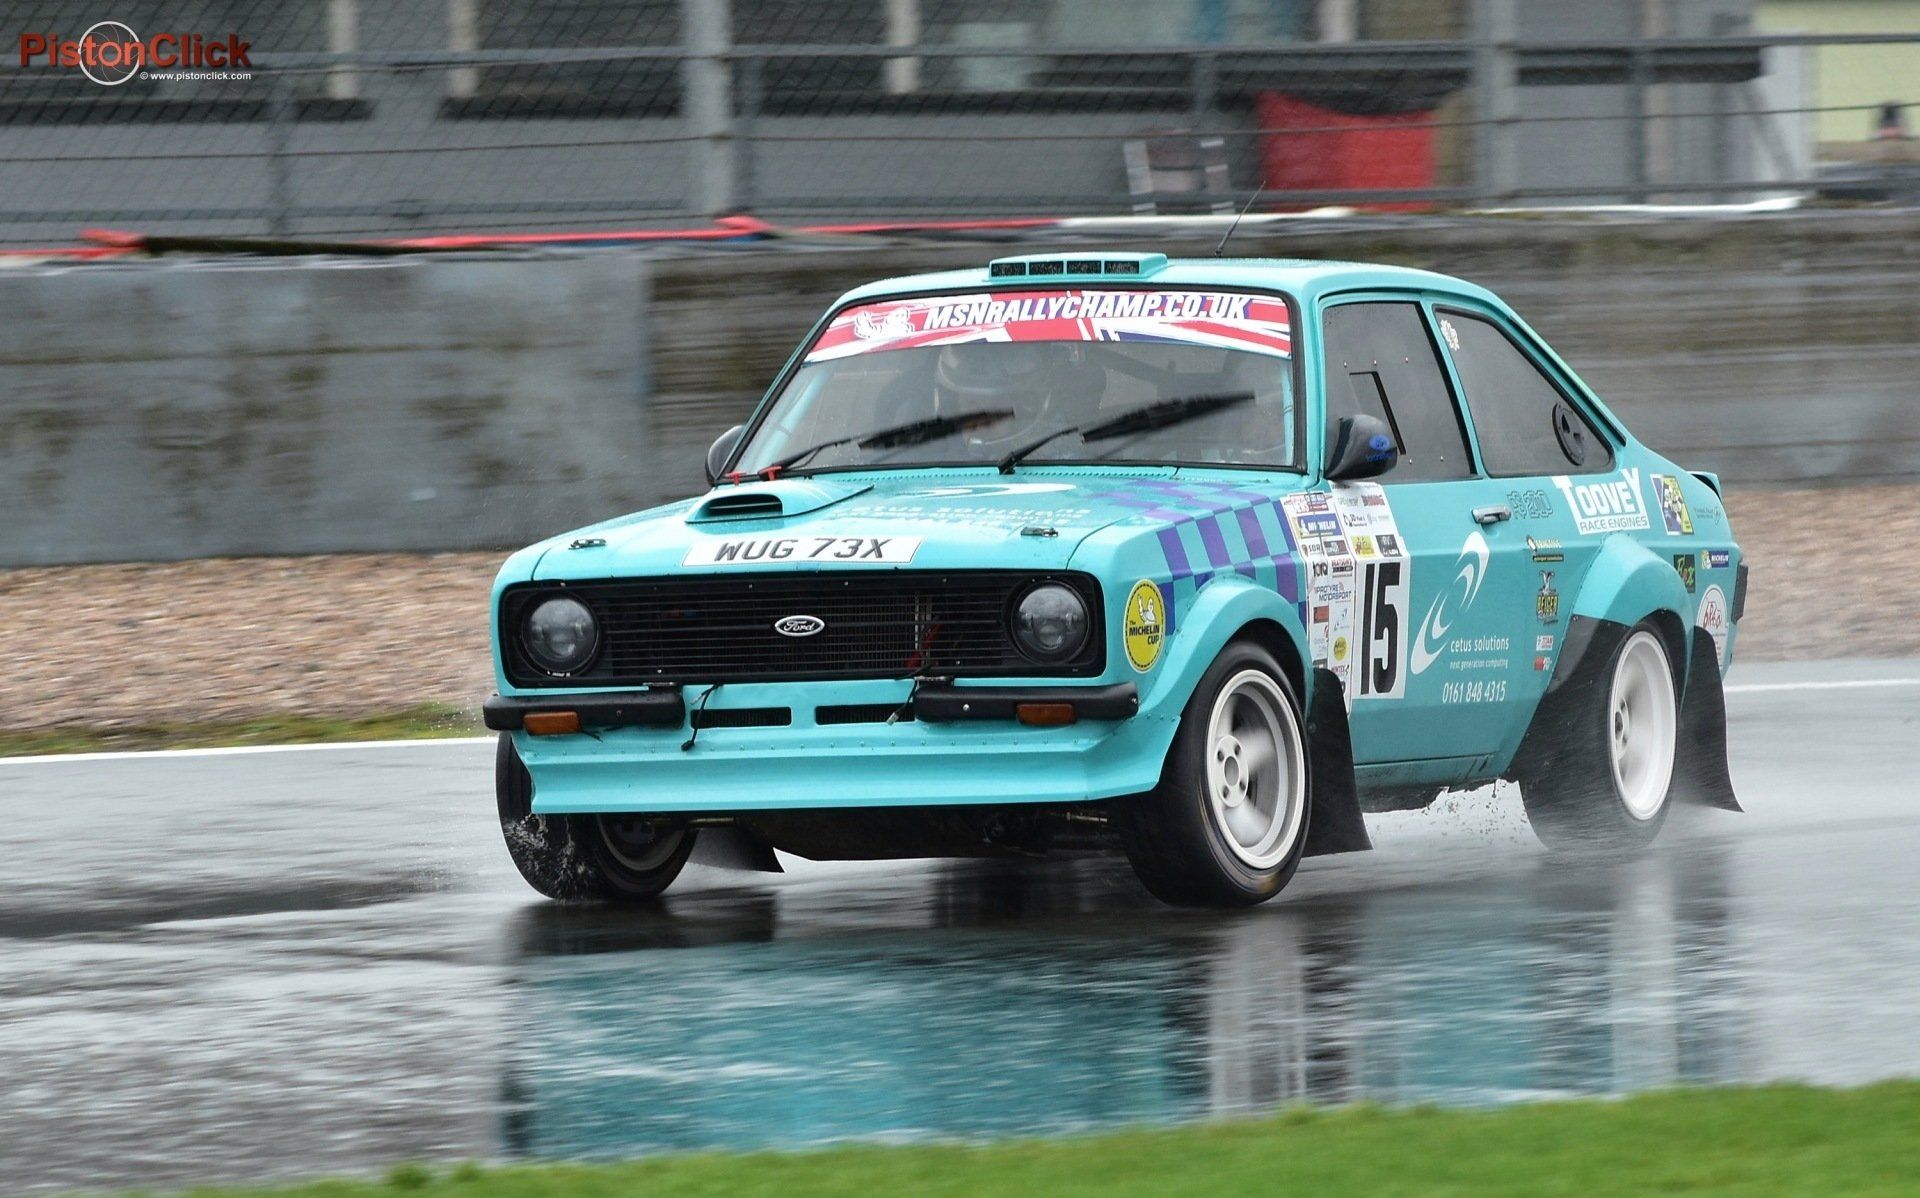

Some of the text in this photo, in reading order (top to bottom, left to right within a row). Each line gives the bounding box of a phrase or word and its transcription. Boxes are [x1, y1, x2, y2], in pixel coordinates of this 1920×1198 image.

[923, 293, 1250, 330] MSNRALLYCHAMP.CO.UK
[1580, 516, 1648, 533] RACE ENGINES
[714, 538, 893, 562] WUG 73X
[783, 620, 815, 633] Ford
[1129, 625, 1160, 636] MICHELIN
[1360, 562, 1401, 695] 15
[1147, 635, 1160, 645] CUP
[1450, 635, 1509, 653] cetus solutions
[1442, 680, 1507, 704] 0161 848 4315
